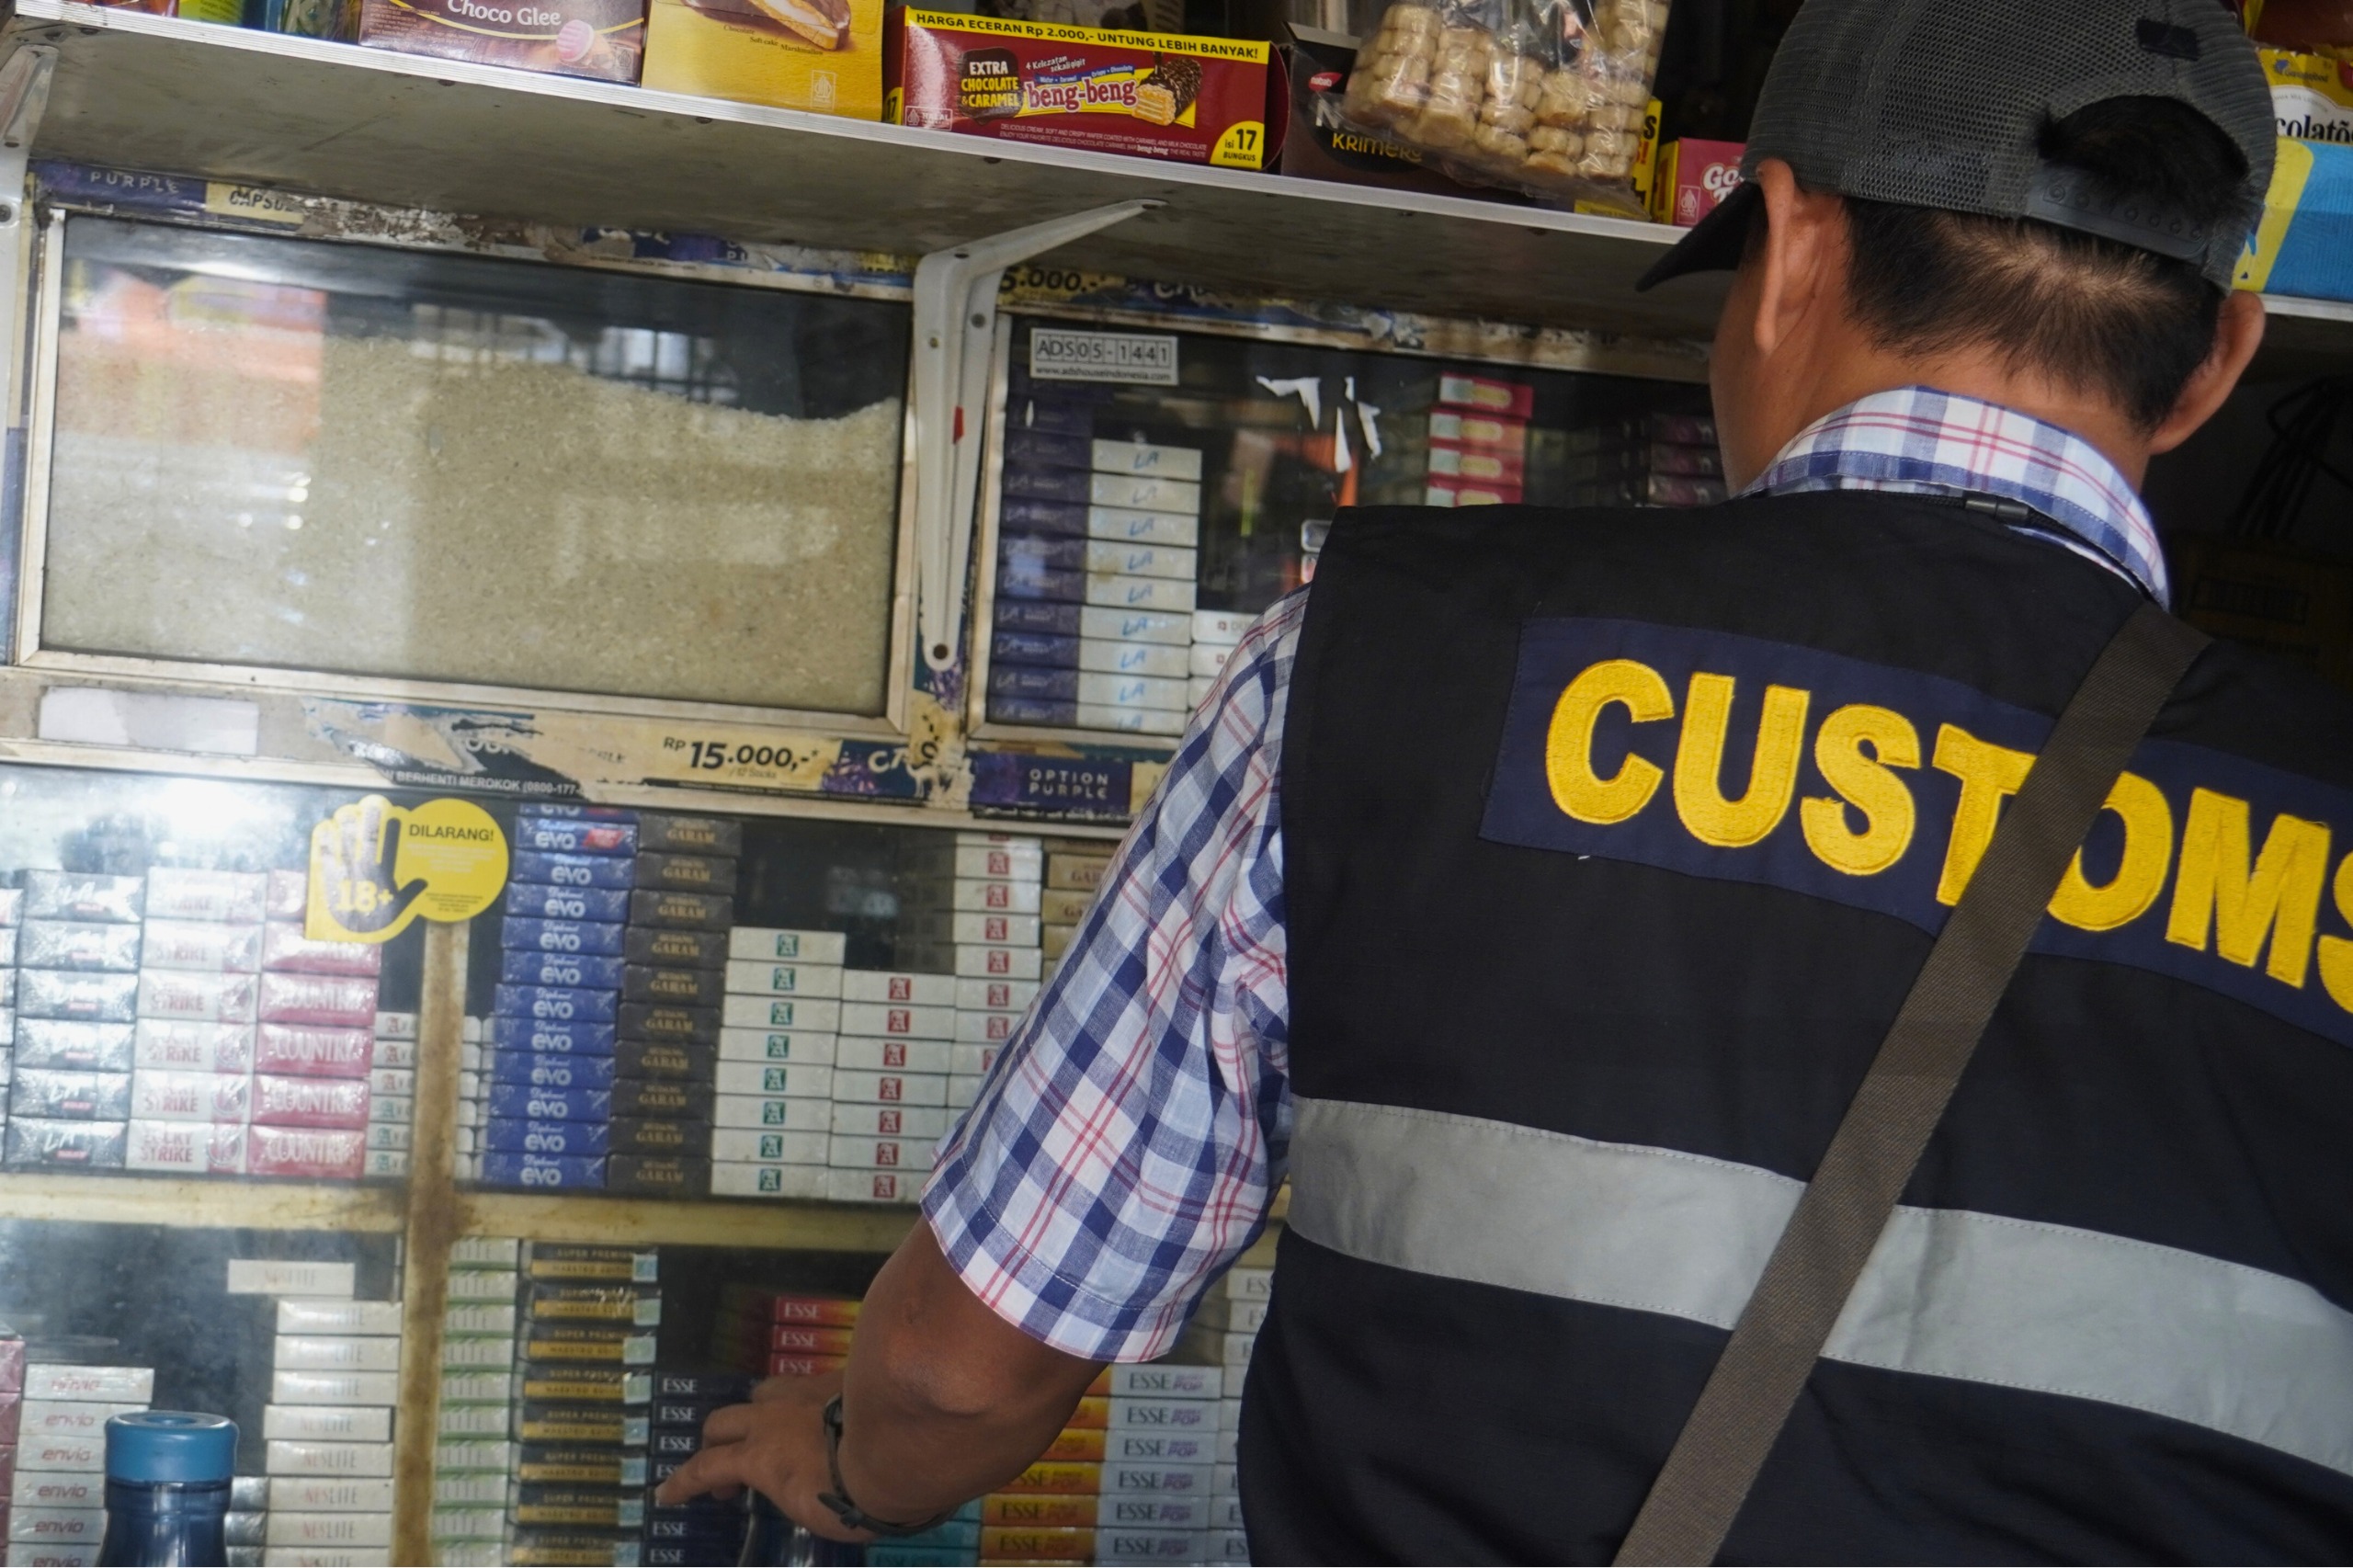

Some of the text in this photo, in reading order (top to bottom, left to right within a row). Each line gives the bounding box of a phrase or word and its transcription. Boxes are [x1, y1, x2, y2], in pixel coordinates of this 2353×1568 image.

[447, 0, 562, 27] Choco Glee
[723, 24, 755, 35] Chocolate
[916, 14, 1258, 59] HARGA ECERAN Rp 2.000,- UNTUNG LEBIH BANYAK!
[781, 44, 823, 55] Marshmallow
[969, 61, 1008, 75] EXTRA
[1026, 62, 1032, 70] 4
[961, 76, 1019, 92] CHOCOLATE
[1025, 77, 1137, 113] beng-beng
[886, 96, 897, 117] 17
[1224, 129, 1256, 152] isi 17
[1222, 151, 1256, 163] BUNGKUS
[91, 172, 179, 194] PURPLE
[397, 770, 458, 787] BERHENTI
[460, 775, 520, 790] MEROKOK
[1029, 768, 1108, 785] OPTION
[1029, 782, 1108, 800] PURPLE
[409, 824, 494, 842] DILARANG!
[535, 832, 576, 850] evo
[552, 866, 591, 884] evo
[336, 880, 394, 913] 18+
[545, 900, 585, 917] evo
[540, 933, 580, 951] evo
[540, 967, 581, 984] evo
[533, 1001, 574, 1019] evo
[531, 1033, 572, 1051] evo
[531, 1067, 572, 1085] evo
[527, 1100, 568, 1119] evo
[525, 1133, 565, 1152] evo
[520, 1167, 562, 1186] evo
[785, 1303, 821, 1318] ESSE
[781, 1332, 817, 1347] ESSE
[779, 1360, 814, 1374] ESSE
[663, 1379, 699, 1393] ESSE
[1129, 1372, 1171, 1390] ESSE
[662, 1407, 696, 1421] ESSE
[1127, 1406, 1168, 1424] ESSE
[660, 1437, 695, 1450] ESSE
[1124, 1438, 1165, 1455] ESSE
[41, 1448, 90, 1461] envio
[1119, 1471, 1160, 1488] ESSE
[39, 1483, 87, 1498] envio
[1116, 1503, 1157, 1519] ESSE
[35, 1518, 85, 1533] envio
[654, 1521, 687, 1537] ESSE
[1113, 1537, 1154, 1553] ESSE
[650, 1549, 685, 1562] ESSE
